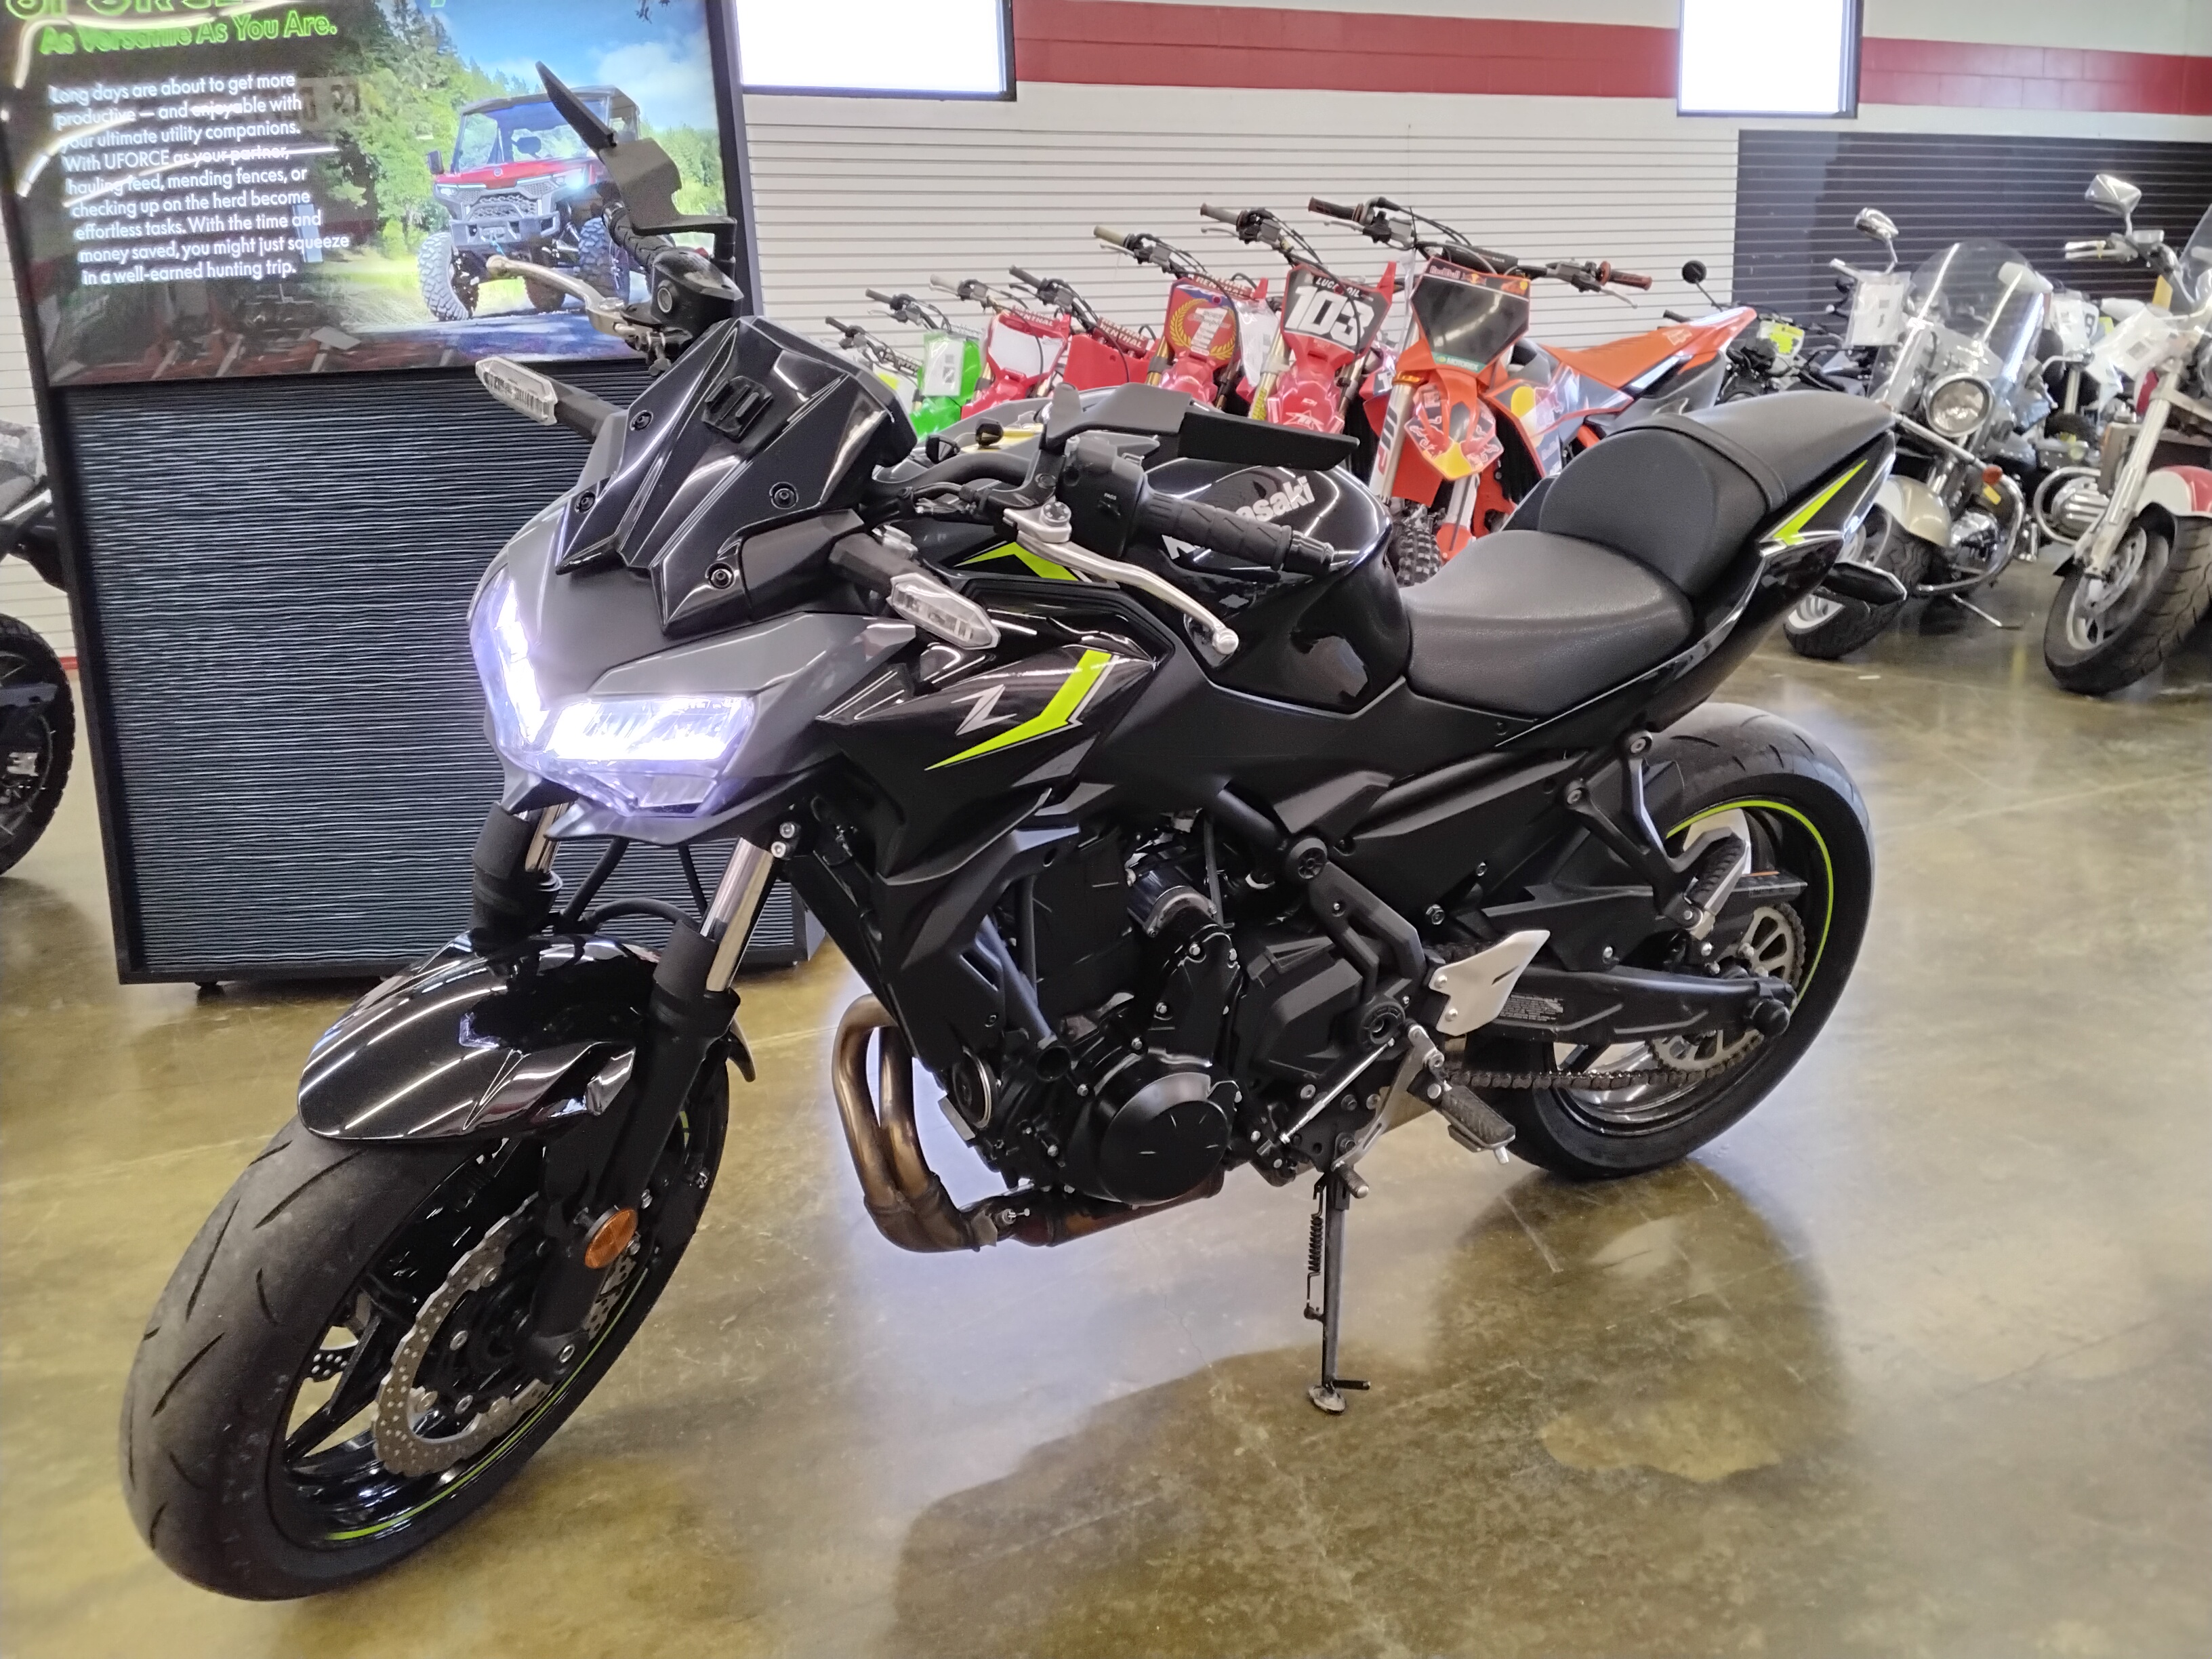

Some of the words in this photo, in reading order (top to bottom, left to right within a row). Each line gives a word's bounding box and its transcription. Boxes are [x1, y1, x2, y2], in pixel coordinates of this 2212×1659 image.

[196, 22, 228, 44] As
[232, 13, 279, 41] You
[283, 10, 337, 37] Are.
[48, 84, 90, 106] Long
[92, 81, 129, 104] days
[132, 83, 157, 98] are
[161, 77, 204, 96] about
[209, 77, 224, 92] to
[228, 74, 253, 96] get
[257, 75, 295, 89] more
[53, 107, 136, 131] productive
[159, 100, 188, 119] and
[190, 96, 266, 120] enjoyable
[269, 94, 302, 112] with
[100, 129, 157, 147] ultimate
[161, 125, 203, 145] utility
[206, 121, 302, 142] companions.
[61, 153, 101, 172] With
[104, 150, 169, 169] UFORCE
[173, 152, 189, 164] as
[194, 150, 227, 168] your
[66, 176, 123, 196] hauling
[127, 173, 165, 191] feed,
[168, 169, 232, 190] mending
[236, 167, 287, 184] fences,
[291, 169, 308, 181] or
[72, 199, 136, 219] checking
[140, 202, 159, 218] up
[163, 200, 182, 211] on
[185, 193, 209, 210] the
[213, 190, 247, 208] herd
[251, 190, 310, 205] become
[75, 221, 142, 240] effortless
[145, 218, 186, 236] tasks.
[188, 215, 225, 233] With
[228, 213, 252, 231] the
[255, 214, 288, 229] time
[292, 209, 321, 226] and
[79, 248, 129, 264] money
[132, 240, 180, 259] saved,
[182, 243, 209, 261] you
[213, 237, 255, 258] might
[260, 237, 285, 257] just
[288, 236, 350, 255] squeeze
[82, 268, 98, 285] in
[101, 272, 110, 284] a
[114, 262, 203, 282] well-earned
[207, 261, 262, 280] hunting
[266, 259, 297, 279] trip.
[1347, 287, 1361, 298] OIL
[1284, 285, 1375, 347] 103
[1099, 323, 1143, 349] RENTHAL
[1446, 356, 1479, 371] MOTOREX
[951, 684, 1017, 737] Z
